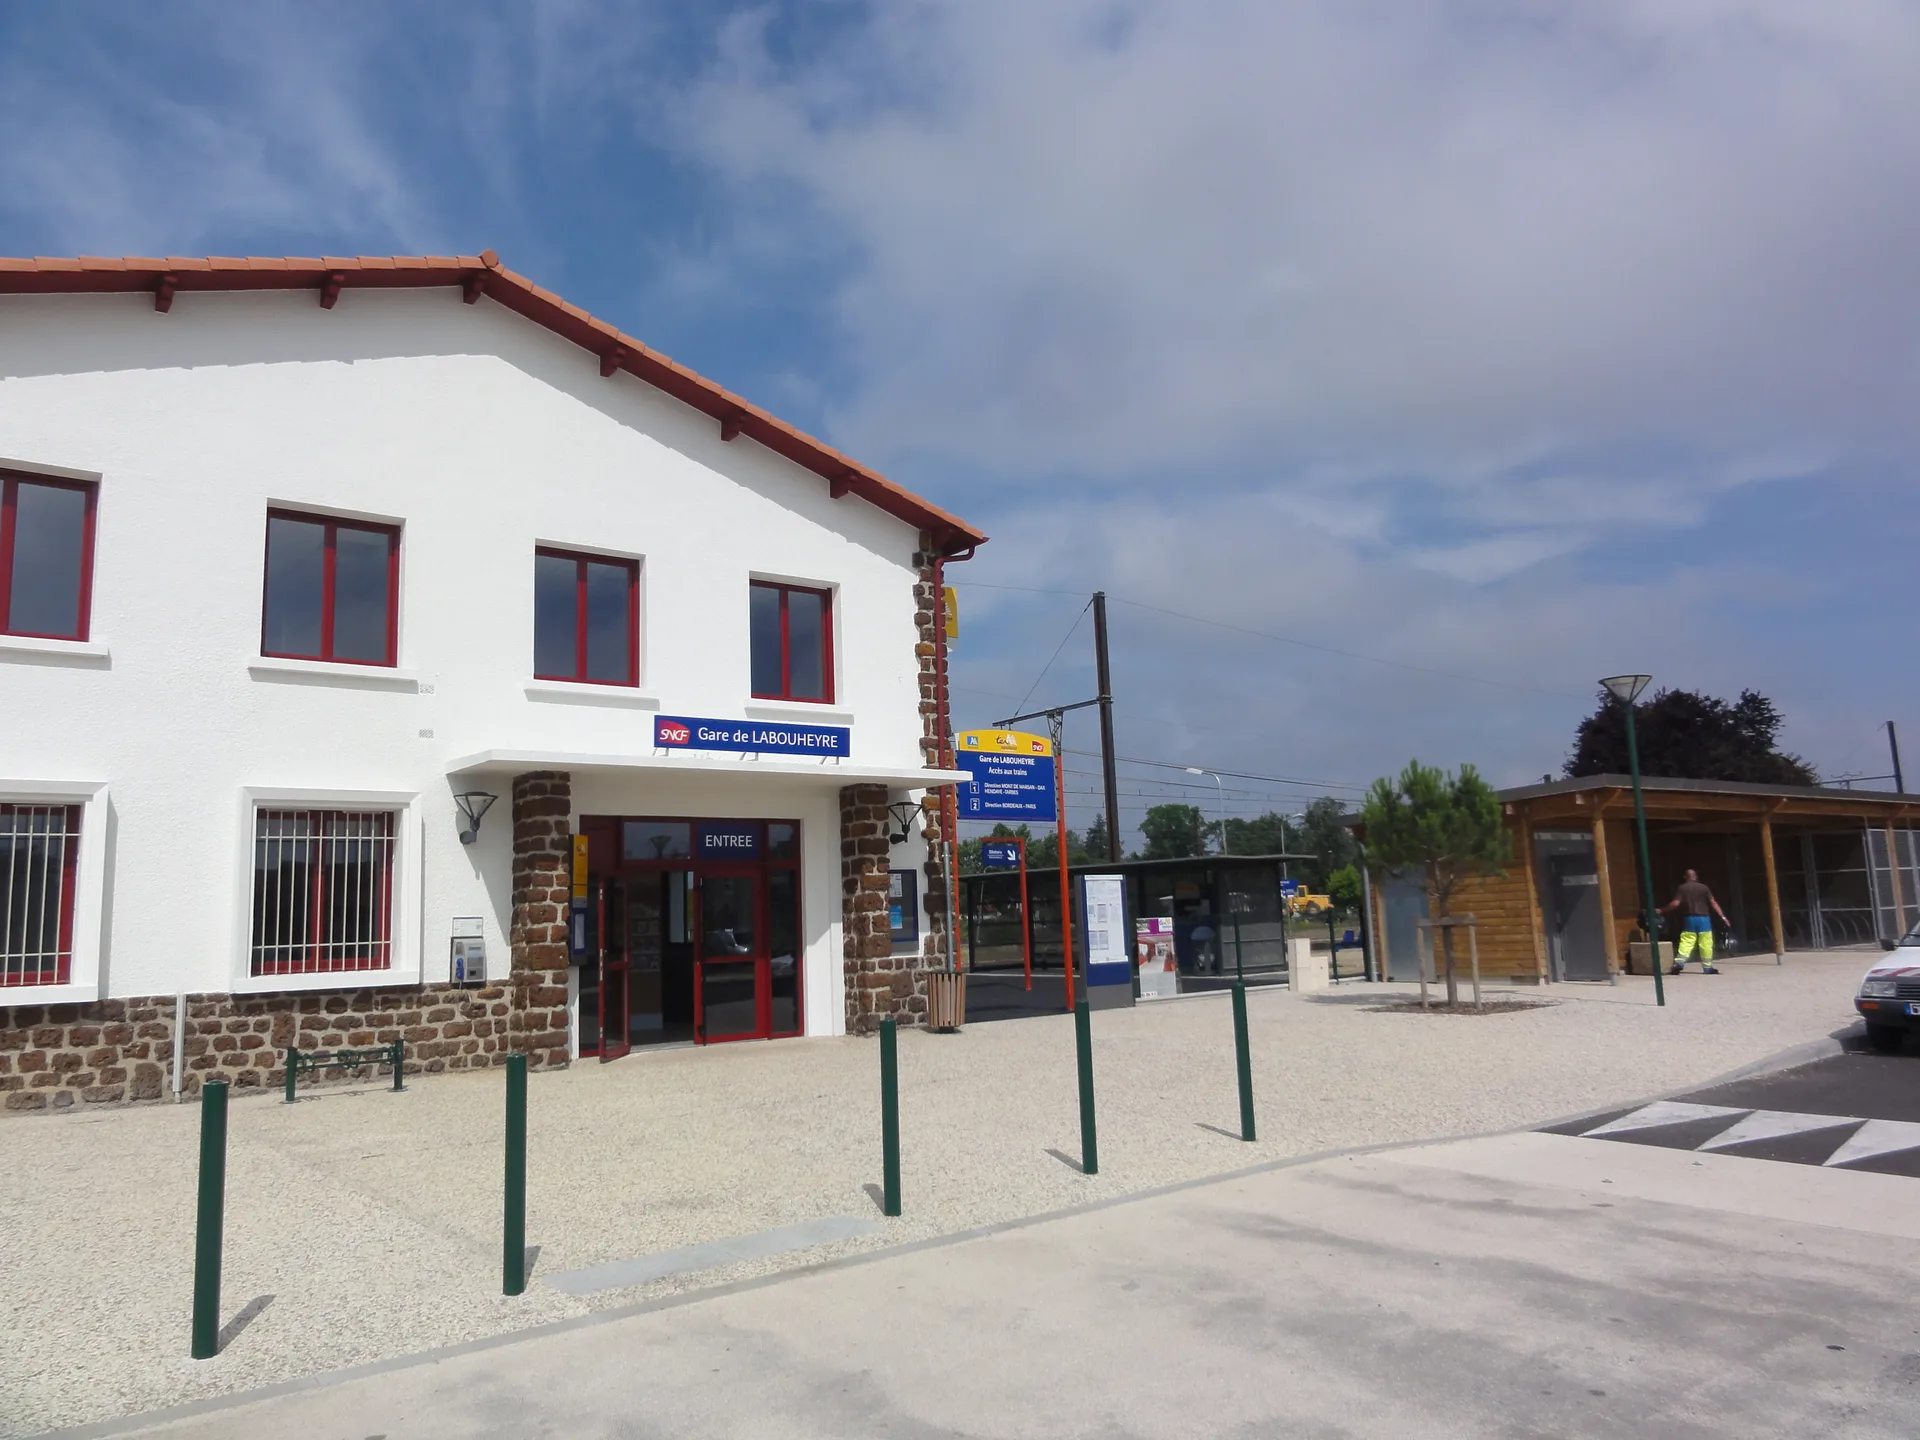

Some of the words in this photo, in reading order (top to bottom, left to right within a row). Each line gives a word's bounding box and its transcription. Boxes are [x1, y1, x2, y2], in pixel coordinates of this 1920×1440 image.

[659, 728, 690, 741] SNCF
[698, 727, 729, 742] Gare
[733, 729, 749, 743] de
[752, 730, 838, 748] LABOUHEYRE
[979, 755, 992, 763] Gare
[1000, 756, 1035, 766] LABOUHEYRE
[988, 766, 1003, 775] Accès
[1013, 768, 1027, 776] trains
[706, 835, 752, 847] ENTREE
